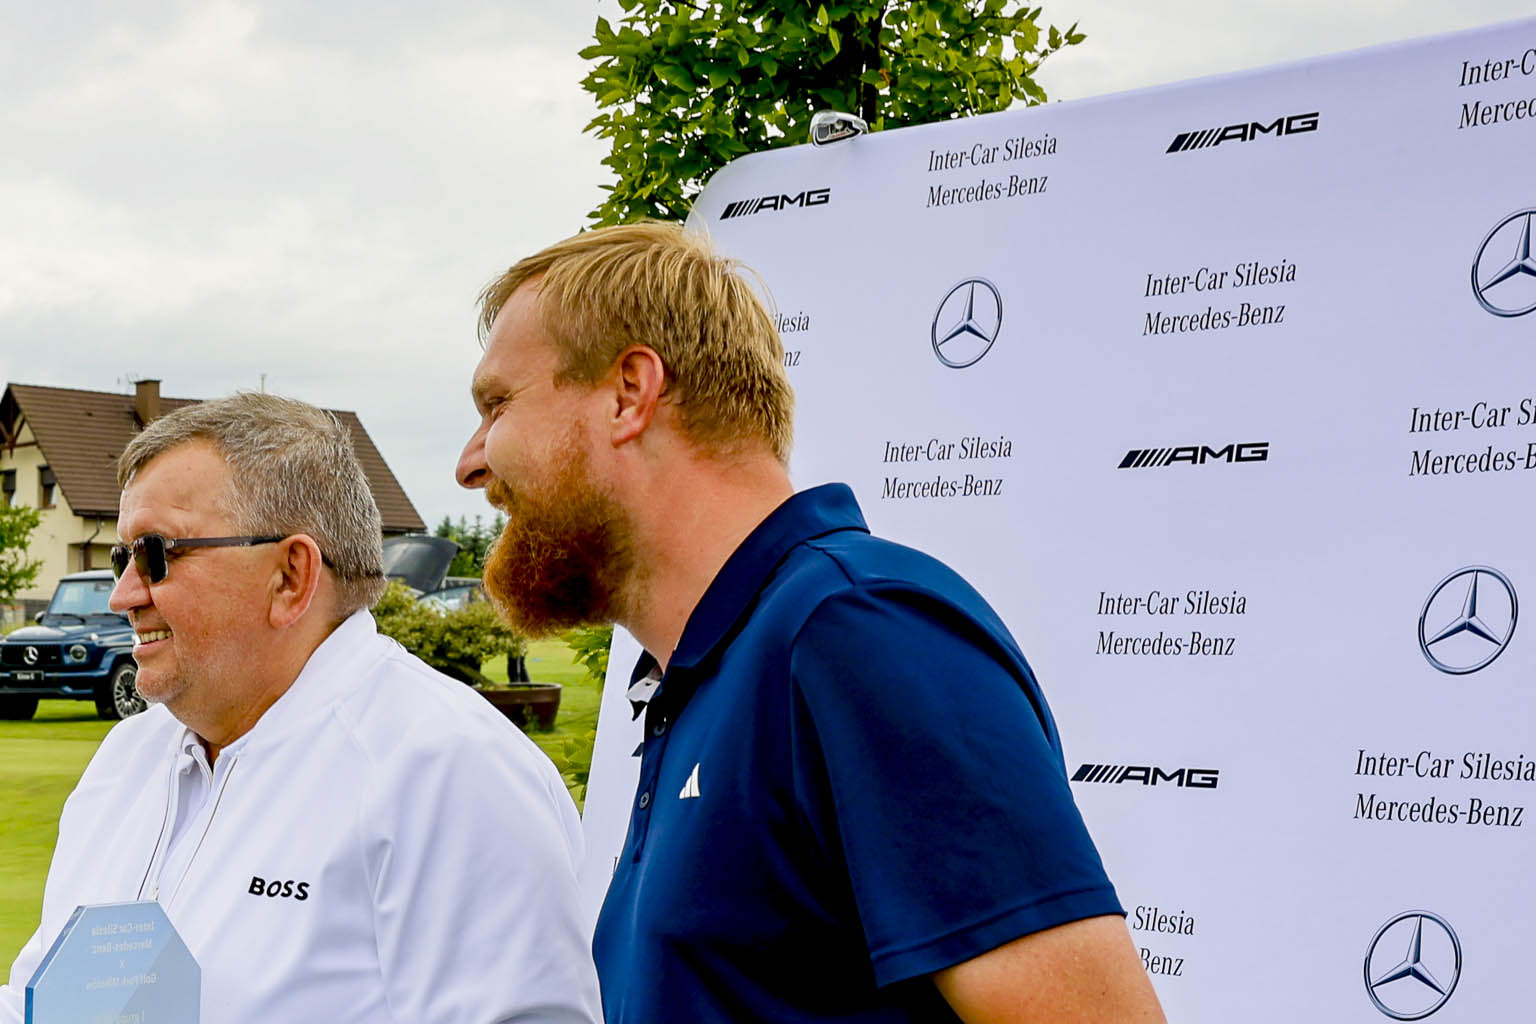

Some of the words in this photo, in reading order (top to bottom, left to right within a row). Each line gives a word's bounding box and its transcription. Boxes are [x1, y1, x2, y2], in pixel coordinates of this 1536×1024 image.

[1458, 48, 1536, 88] Inter-C
[1215, 112, 1319, 146] AMG
[928, 144, 999, 171] Inter-Car
[1003, 134, 1056, 161] Silesia
[753, 187, 830, 214] AMG
[927, 175, 1048, 208] Mercedes-Benz
[1144, 268, 1228, 297] Inter-Car
[1233, 259, 1296, 287] Silesia
[773, 311, 810, 334] ilesia
[1143, 303, 1285, 336] Mercedes-Benz
[1409, 400, 1511, 433] Inter-Car
[884, 439, 955, 462] Inter-Car
[959, 436, 1011, 459] Silesia
[1169, 442, 1269, 466] AMG
[1409, 442, 1536, 476] Mercedes-B
[882, 475, 1002, 499] Mercedes-Benz
[1097, 591, 1179, 615] Inter-Car
[1184, 590, 1246, 614] Silesia
[1096, 631, 1235, 655] Mercedes-Benz
[1119, 766, 1219, 788] AMG
[1355, 750, 1454, 778] Inter-Car
[1460, 752, 1536, 782] Silesia
[1354, 793, 1524, 826] Mercedes-Benz
[248, 876, 311, 901] BOSS
[1133, 906, 1194, 935] Silesia
